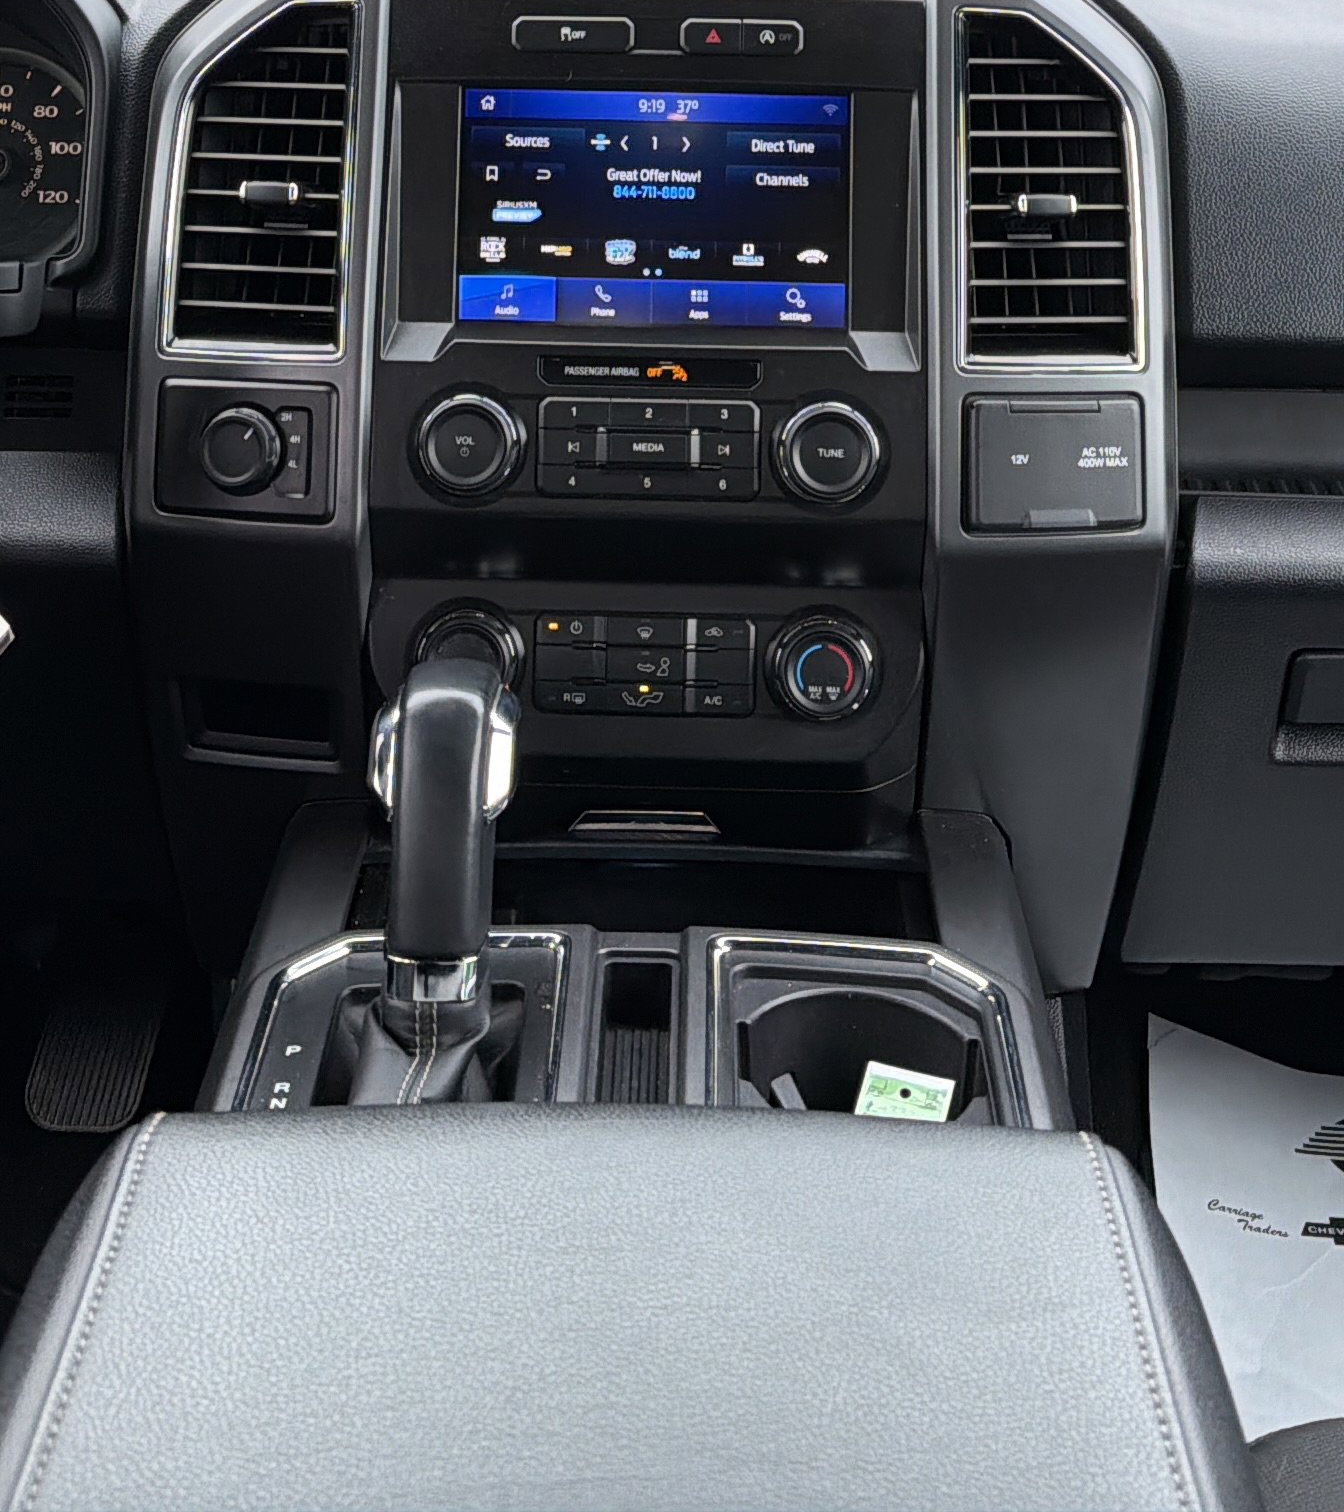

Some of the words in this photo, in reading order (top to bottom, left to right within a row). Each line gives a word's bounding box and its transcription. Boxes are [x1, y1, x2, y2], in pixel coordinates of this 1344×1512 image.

[572, 30, 586, 39] OFF
[33, 105, 58, 118] 80
[638, 99, 666, 113] 9:19
[10, 120, 26, 132] 120
[505, 133, 550, 148] Sources
[751, 139, 784, 152] Direct
[787, 140, 815, 154] Tune
[49, 142, 82, 154] 100
[607, 168, 638, 182] Great
[640, 169, 668, 182] Offer
[671, 170, 701, 183] Now!
[756, 173, 809, 186] Channels
[37, 190, 68, 204] 120
[613, 185, 695, 200] 844-711-8800
[668, 248, 700, 260] blend
[494, 305, 520, 316] Audio
[590, 306, 615, 317] Phone
[688, 309, 709, 320] Apps
[780, 311, 812, 323] Settings
[564, 366, 610, 376] PASSENGER
[610, 367, 640, 377] AIRBAG
[646, 368, 663, 378] OFF
[280, 412, 293, 422] 2H
[571, 406, 577, 416] 1
[645, 408, 653, 418] 2
[720, 409, 728, 420] 3
[290, 434, 301, 444] 4H
[455, 436, 475, 446] VOL
[632, 442, 664, 452] MEDIA
[816, 448, 846, 458] TUNE
[1082, 446, 1096, 458] AC
[1098, 446, 1122, 456] 110V
[288, 459, 298, 468] 4L
[1010, 454, 1030, 465] 12V
[1078, 458, 1104, 468] 400W
[1106, 456, 1128, 468] MAX
[568, 476, 576, 486] 4
[644, 478, 651, 488] 5
[718, 479, 726, 490] 6
[704, 695, 722, 706] A/C
[285, 1044, 302, 1056] P
[274, 1082, 290, 1094] R
[270, 1097, 288, 1110] N
[1208, 1198, 1264, 1221] Carriage
[1237, 1218, 1289, 1238] Traders
